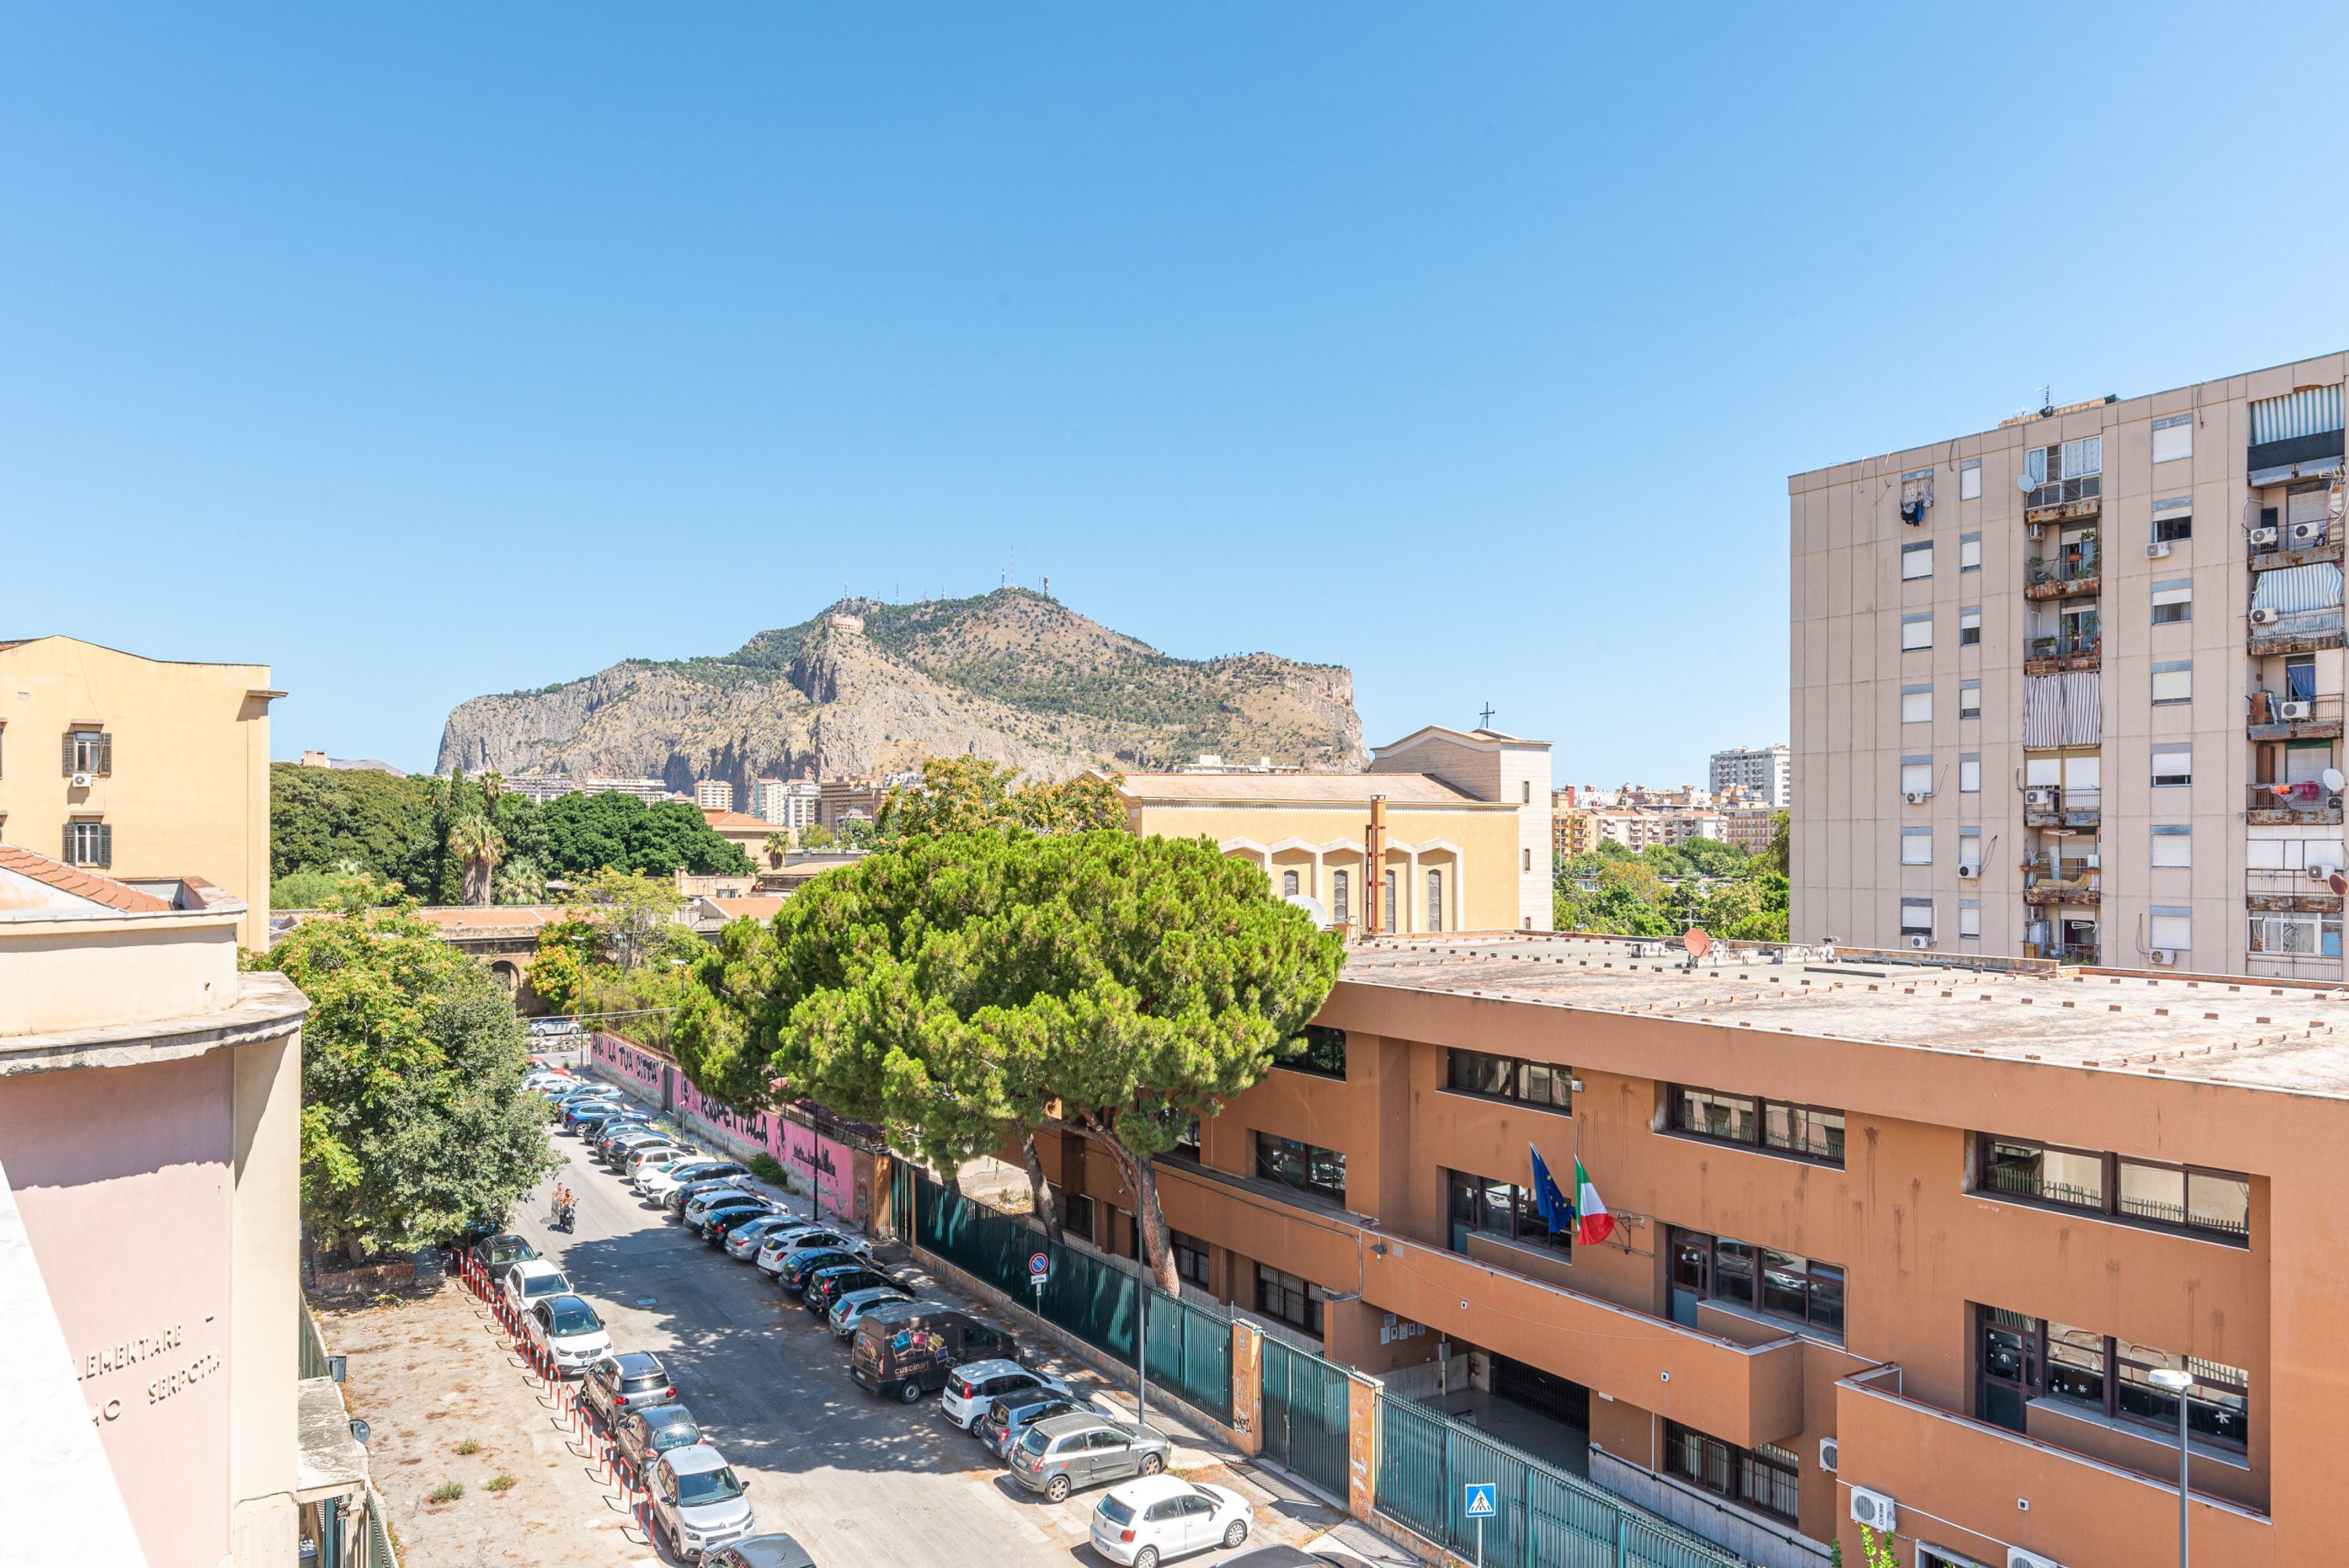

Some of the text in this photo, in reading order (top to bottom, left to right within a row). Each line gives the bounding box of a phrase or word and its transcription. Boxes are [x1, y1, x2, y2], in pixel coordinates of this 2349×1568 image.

[608, 1040, 616, 1062] LA
[619, 1047, 633, 1072] TUA
[894, 1361, 929, 1375] cuscinart
